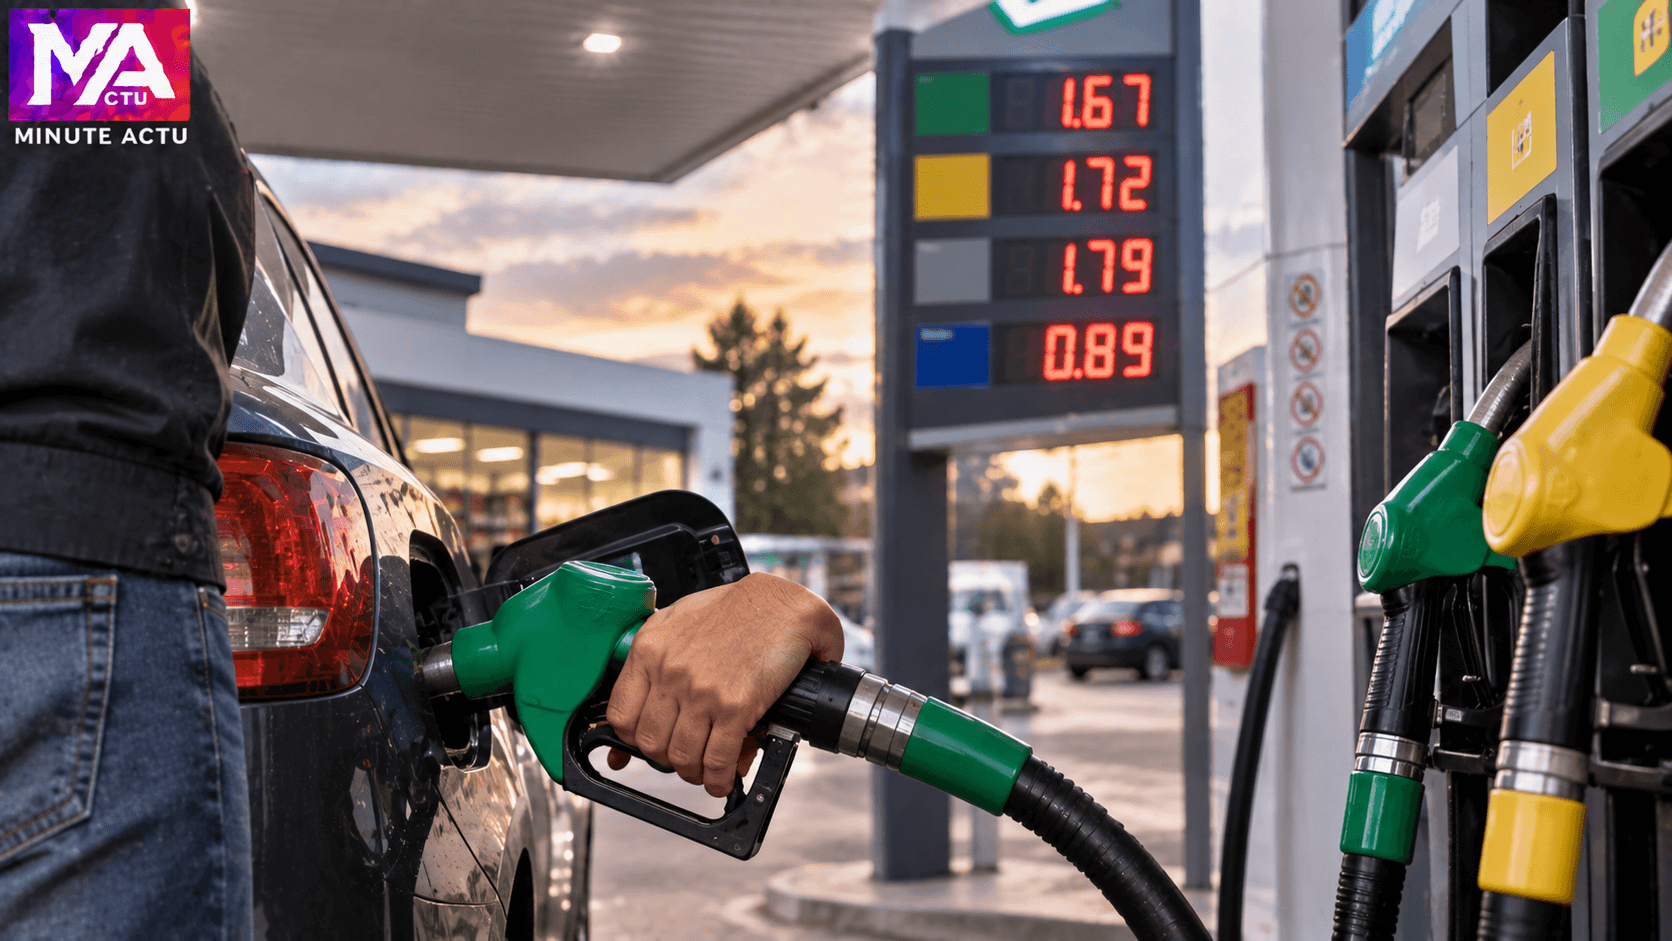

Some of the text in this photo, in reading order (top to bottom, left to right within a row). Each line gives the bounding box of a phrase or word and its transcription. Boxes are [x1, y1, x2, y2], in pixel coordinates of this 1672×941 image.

[1061, 73, 1152, 129] 1.67
[1061, 155, 1152, 212] 1.72
[1061, 238, 1153, 295] 1.79
[1043, 321, 1154, 381] 0.89
